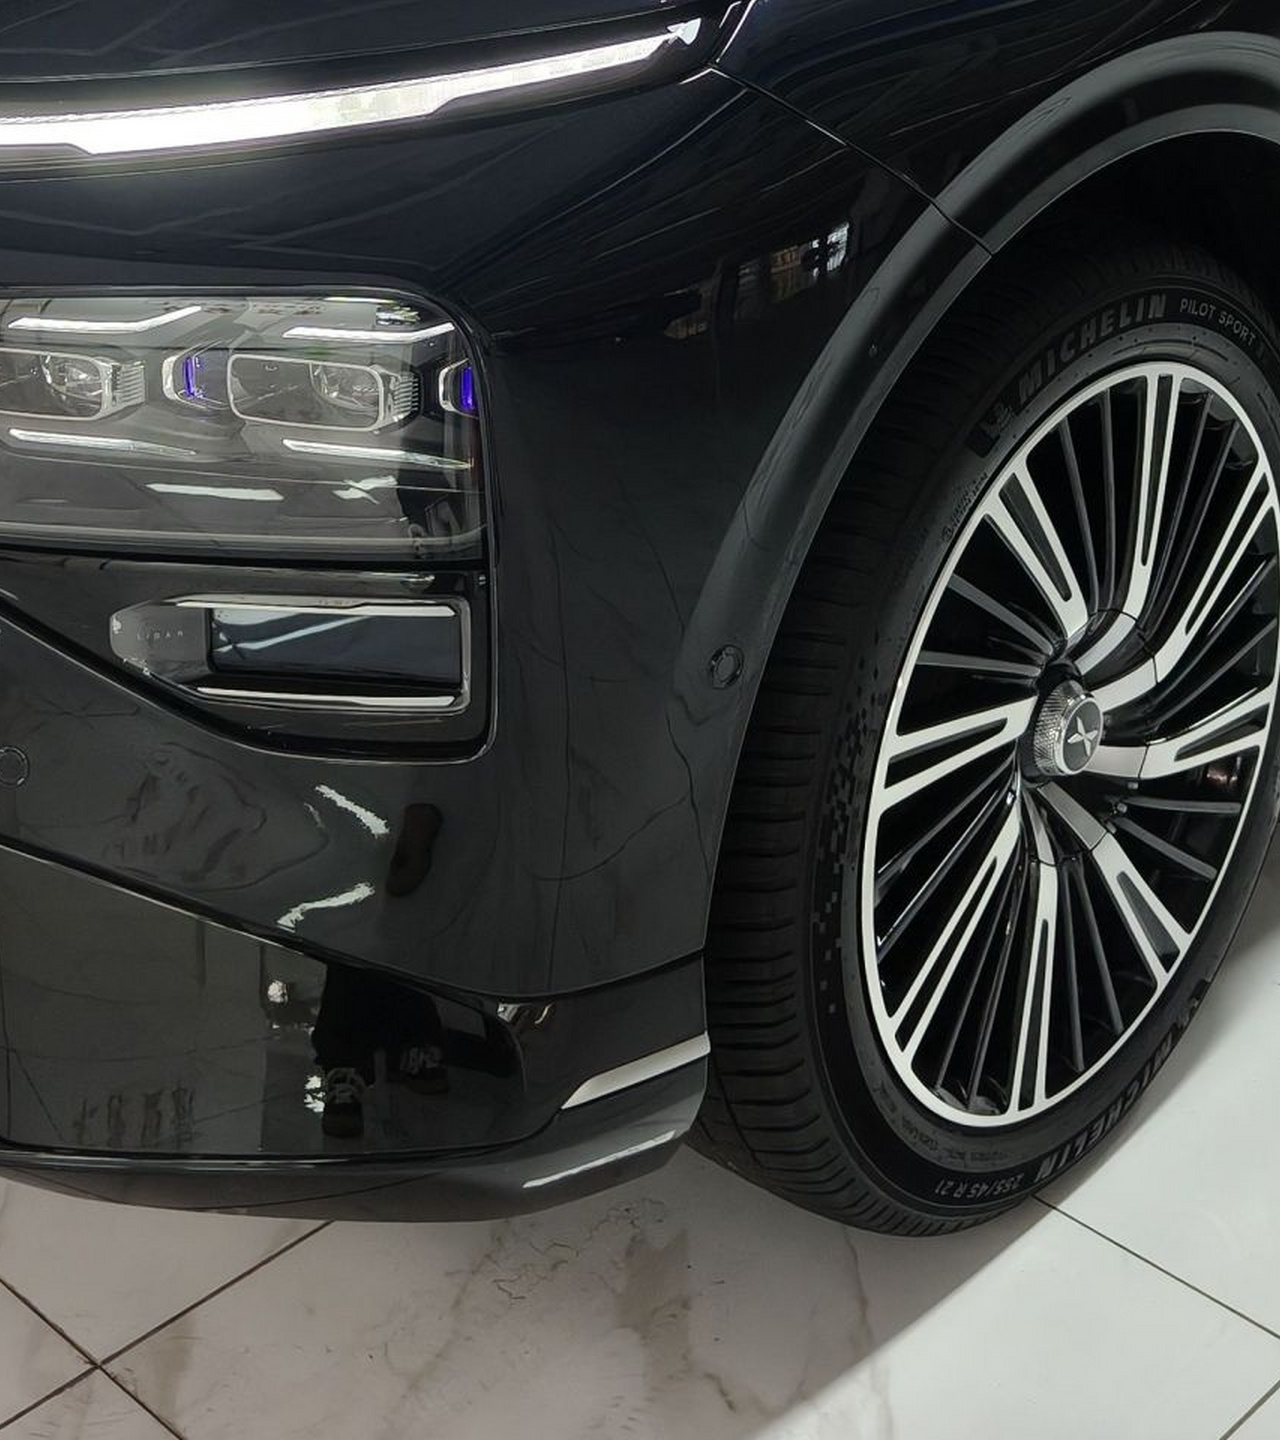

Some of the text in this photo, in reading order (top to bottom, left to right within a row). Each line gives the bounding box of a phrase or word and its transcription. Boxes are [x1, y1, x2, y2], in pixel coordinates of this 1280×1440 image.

[1018, 293, 1257, 406] MICHELIN PILOT SPORT
